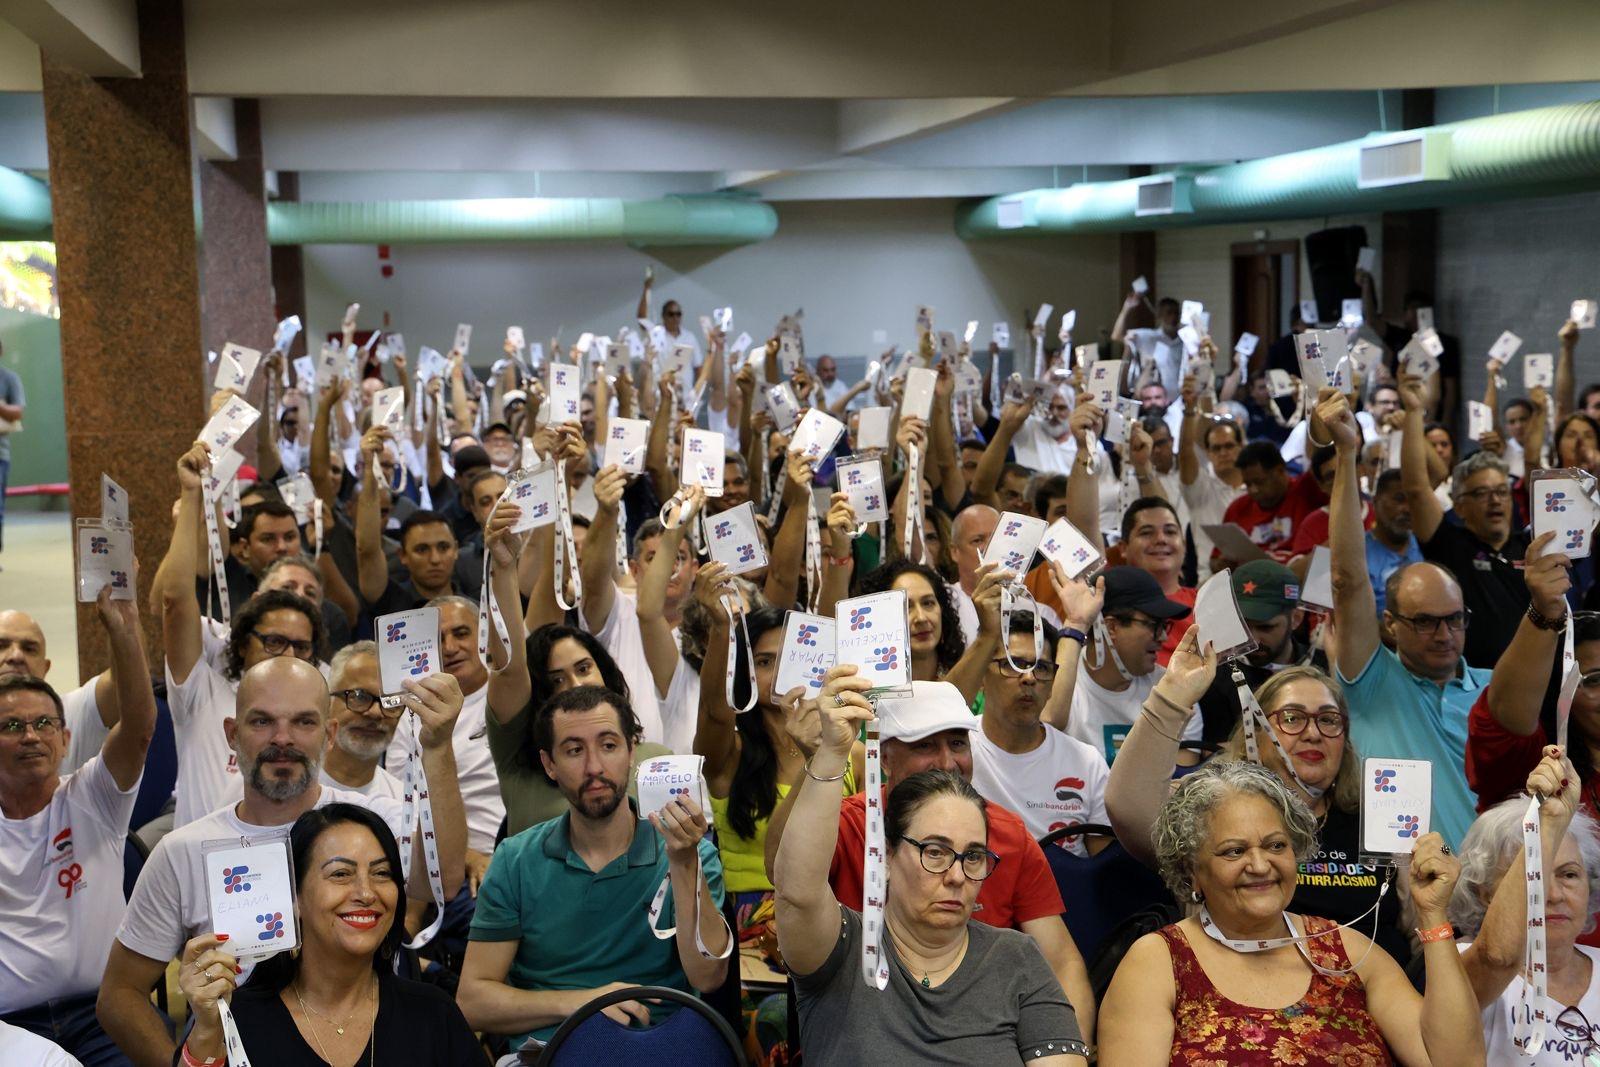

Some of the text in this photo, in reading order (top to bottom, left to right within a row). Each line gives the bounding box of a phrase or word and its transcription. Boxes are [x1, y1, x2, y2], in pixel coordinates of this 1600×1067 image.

[642, 773, 692, 786] MARCELO
[1329, 850, 1347, 860] de
[1298, 862, 1364, 875] ERSIDADE
[1296, 873, 1377, 887] NTIRRACISMO
